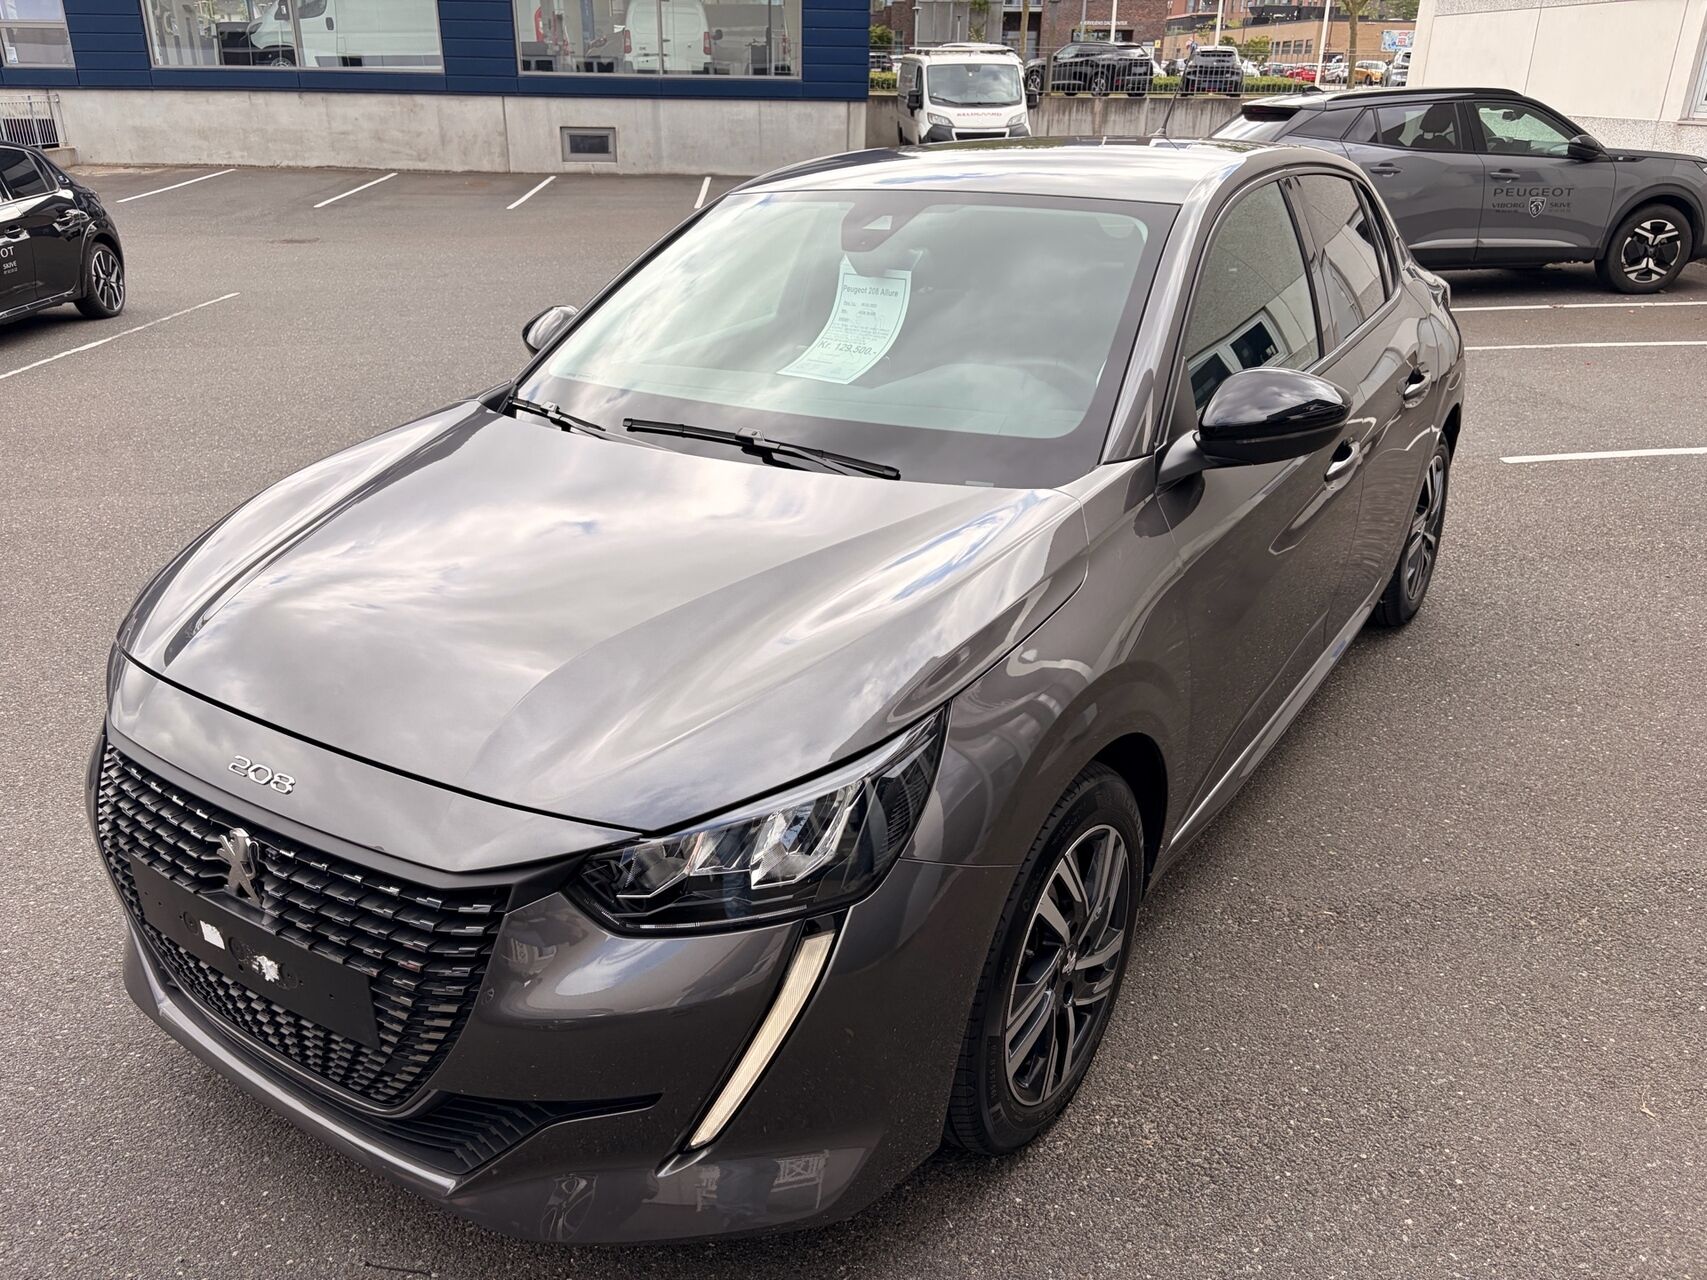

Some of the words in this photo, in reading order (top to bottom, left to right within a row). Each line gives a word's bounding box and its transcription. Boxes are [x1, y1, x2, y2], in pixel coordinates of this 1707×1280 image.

[1493, 187, 1575, 197] PEUGEOT
[0, 246, 14, 258] OT
[842, 284, 867, 295] Peugeot
[868, 286, 879, 296] 208
[880, 287, 899, 298] Allure
[228, 755, 296, 795] 208
